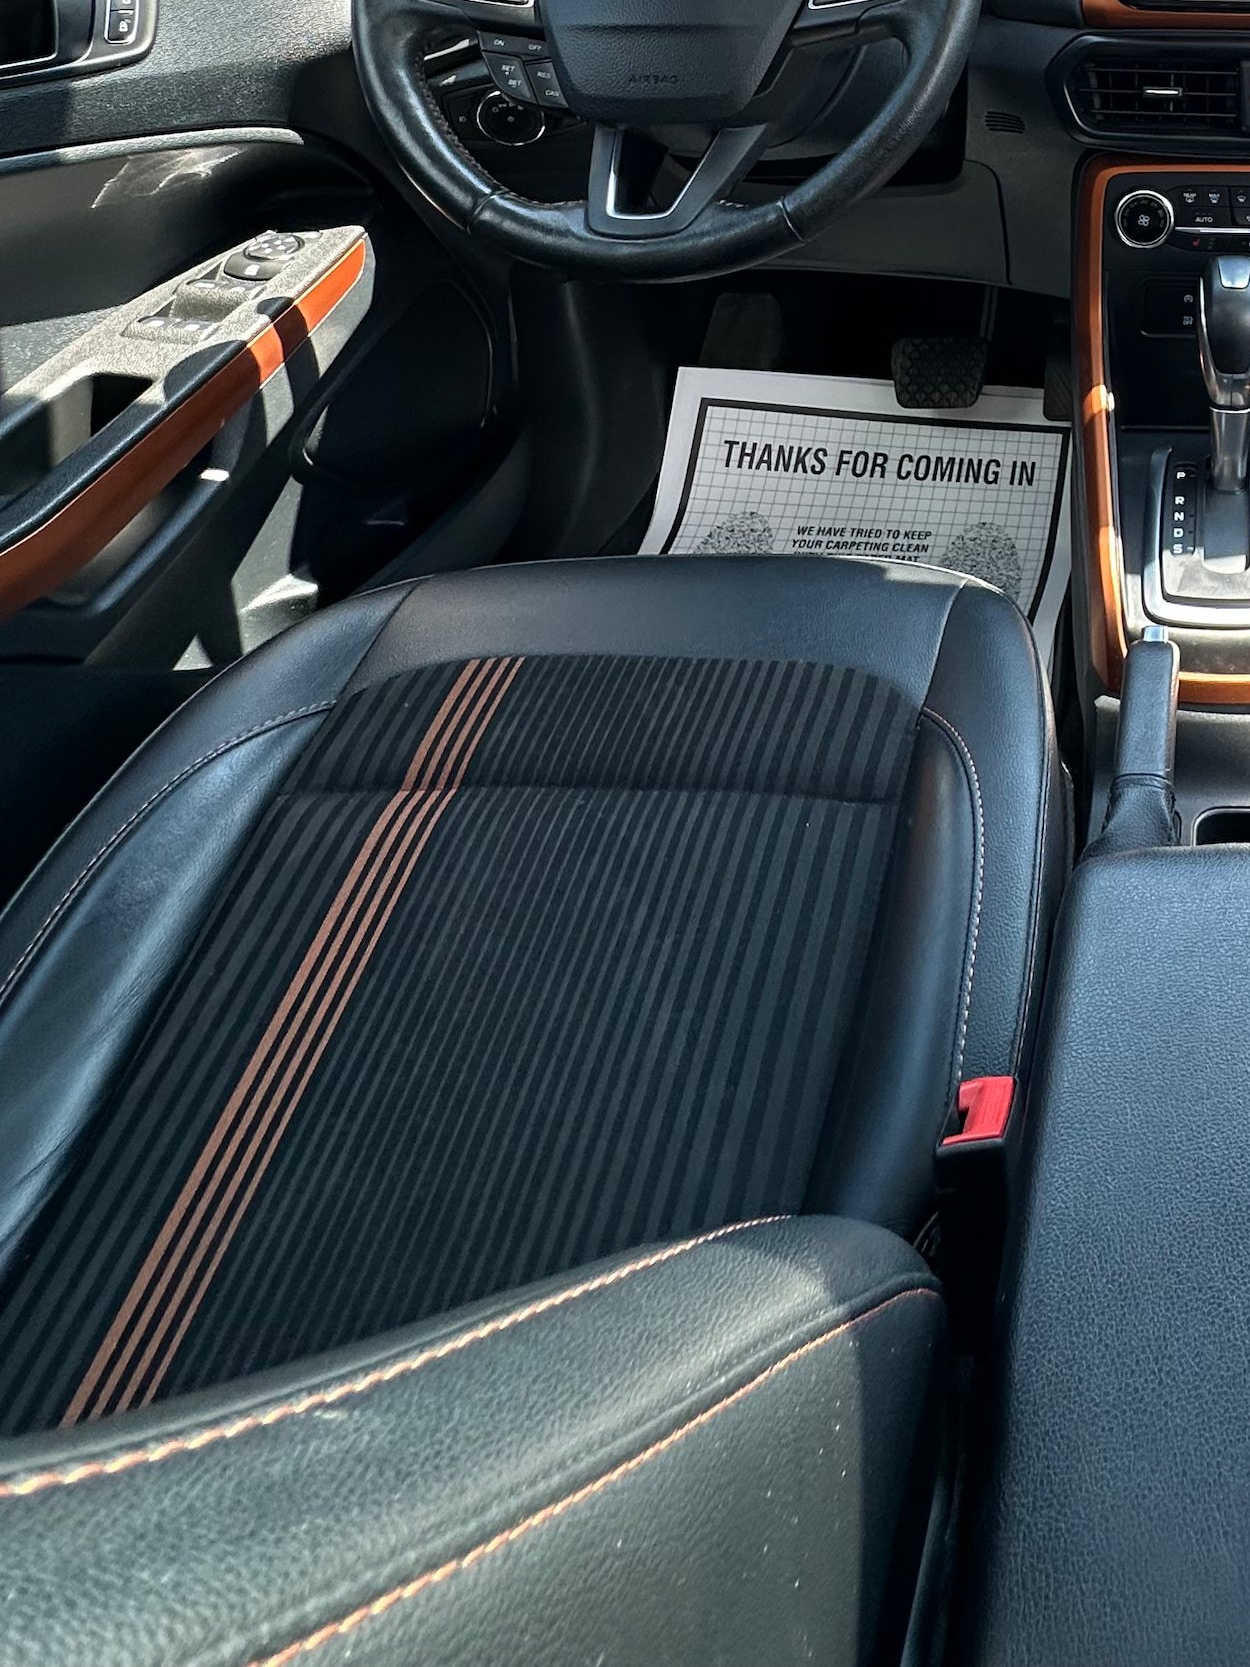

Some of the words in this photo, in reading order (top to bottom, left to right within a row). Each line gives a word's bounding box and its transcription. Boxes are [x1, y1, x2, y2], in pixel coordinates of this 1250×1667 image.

[494, 38, 506, 46] ON
[536, 71, 552, 79] RES
[628, 74, 679, 84] AIRBAG
[724, 440, 828, 476] THANKS
[835, 450, 888, 480] FOR
[896, 453, 1001, 485] COMING
[1009, 460, 1036, 486] IN
[1176, 472, 1186, 480] P
[1174, 496, 1186, 505] R
[1174, 512, 1184, 522] N
[797, 526, 816, 536] WE
[816, 526, 847, 538] HAVE
[850, 527, 882, 539] TRIED
[886, 529, 900, 540] TO
[903, 530, 932, 540] KEEP
[1174, 528, 1184, 538] D
[792, 538, 824, 549] YOUR
[825, 540, 889, 552] CARPETING
[892, 542, 930, 554] CLEAN
[1172, 544, 1183, 554] S
